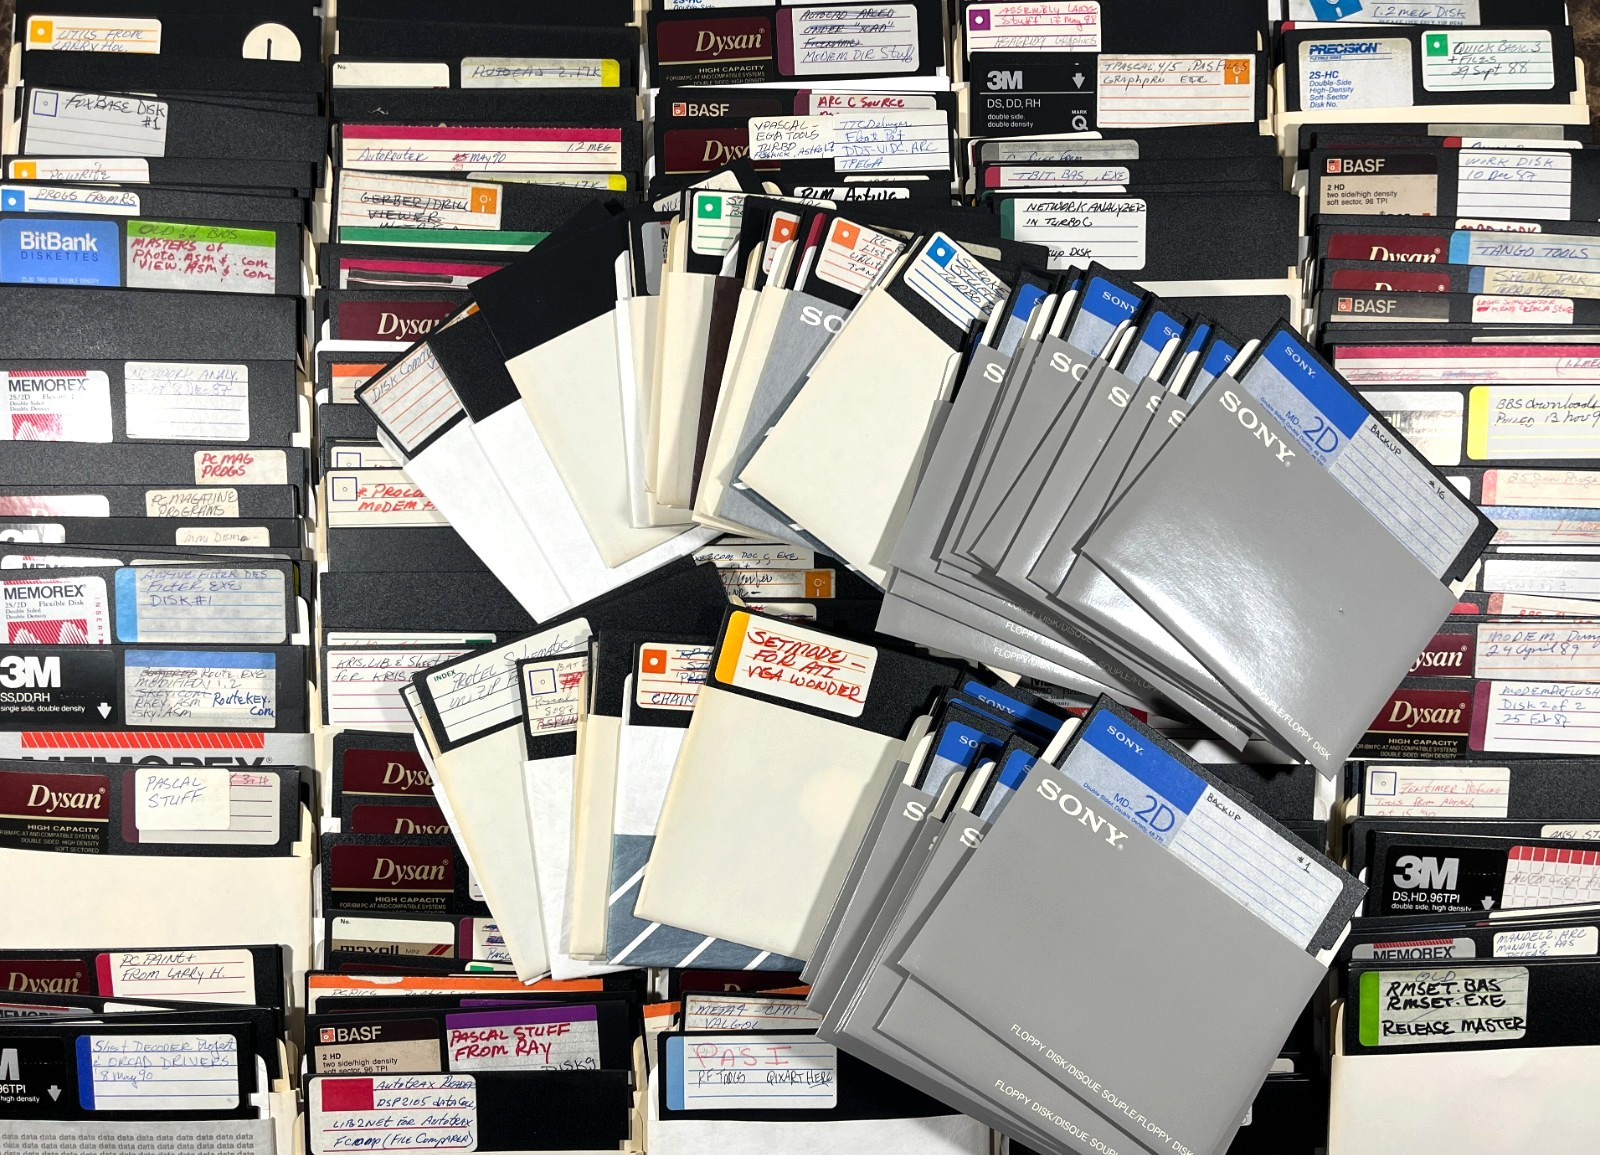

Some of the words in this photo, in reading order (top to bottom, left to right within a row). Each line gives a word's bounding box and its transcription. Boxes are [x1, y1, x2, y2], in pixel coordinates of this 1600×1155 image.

[696, 31, 762, 56] Dysan
[1309, 42, 1378, 55] PRECISION
[986, 70, 1023, 90] 3M
[1309, 70, 1340, 79] 2S-HC
[688, 103, 730, 117] BASF
[987, 113, 1008, 121] double
[142, 116, 161, 130] #1
[1010, 121, 1034, 129] density
[1071, 116, 1088, 131] Q
[702, 139, 749, 162] Dys
[1343, 159, 1385, 173] BASF
[1340, 190, 1371, 199] side/high
[1372, 190, 1398, 199] density
[1365, 198, 1374, 206] 96
[20, 231, 98, 252] BitBank
[20, 252, 98, 263] DISKETTES
[1370, 246, 1437, 264] Dysan
[1102, 290, 1138, 314] SONY
[1354, 299, 1397, 313] BASF
[1284, 346, 1315, 376] SONY
[8, 379, 87, 393] MEMOREX
[1219, 390, 1295, 462] SONY
[1370, 424, 1402, 456] BACKUP
[4, 584, 84, 600] MEMOREX
[38, 600, 65, 608] Flexible
[753, 649, 796, 668] FOR
[799, 661, 841, 679] ATI
[1409, 648, 1463, 673] ysan
[0, 656, 61, 688] 3M
[433, 669, 456, 682] INDEX
[790, 673, 865, 704] WONDER
[0, 705, 19, 714] single
[37, 705, 60, 713] double
[61, 705, 86, 714] density
[977, 694, 1015, 716] SONY
[1389, 700, 1462, 728] Dysan
[1106, 725, 1142, 754] SONY
[1311, 738, 1332, 761] DISK
[382, 762, 434, 790] Dys
[27, 784, 102, 813] Dysan
[1206, 792, 1241, 821] BACKUP
[1036, 778, 1129, 848] SONY
[53, 825, 100, 833] CAPACITY
[372, 858, 445, 885] Dysan
[1393, 855, 1460, 890] 3M
[400, 896, 446, 904] CAPACITY
[1392, 891, 1460, 904] DS,HD,96TPI
[1391, 902, 1413, 911] double
[1432, 904, 1446, 912] high
[340, 944, 400, 955] maxell
[1373, 946, 1454, 959] MEMOREX
[8, 972, 79, 992] Dysan
[337, 1026, 382, 1042] BASF
[1461, 1016, 1527, 1035] MASTER
[450, 1029, 508, 1047] PASCAL
[514, 1023, 571, 1037] STUFF
[454, 1043, 508, 1061] FROM
[515, 1039, 552, 1064] RAY
[337, 1059, 370, 1068] side/high
[372, 1057, 398, 1067] density
[1010, 1023, 1046, 1052] FLOPPY
[1045, 1049, 1102, 1094] DISK/DISQUE
[1101, 1089, 1173, 1144] SOUPLE/FLOPPY
[1, 1095, 16, 1104] high
[16, 1095, 40, 1104] density
[994, 1079, 1031, 1106] FLOPPY
[1031, 1102, 1089, 1143] DISK/DISQUE
[2, 1133, 18, 1141] data
[21, 1133, 37, 1141] data
[40, 1133, 56, 1141] data
[59, 1133, 75, 1141] data
[78, 1133, 95, 1141] data
[98, 1133, 114, 1141] data
[117, 1133, 134, 1141] data
[137, 1133, 153, 1141] data
[157, 1133, 173, 1141] data
[176, 1133, 193, 1141] data
[196, 1133, 213, 1141] data
[216, 1133, 233, 1141] data
[236, 1133, 253, 1141] data
